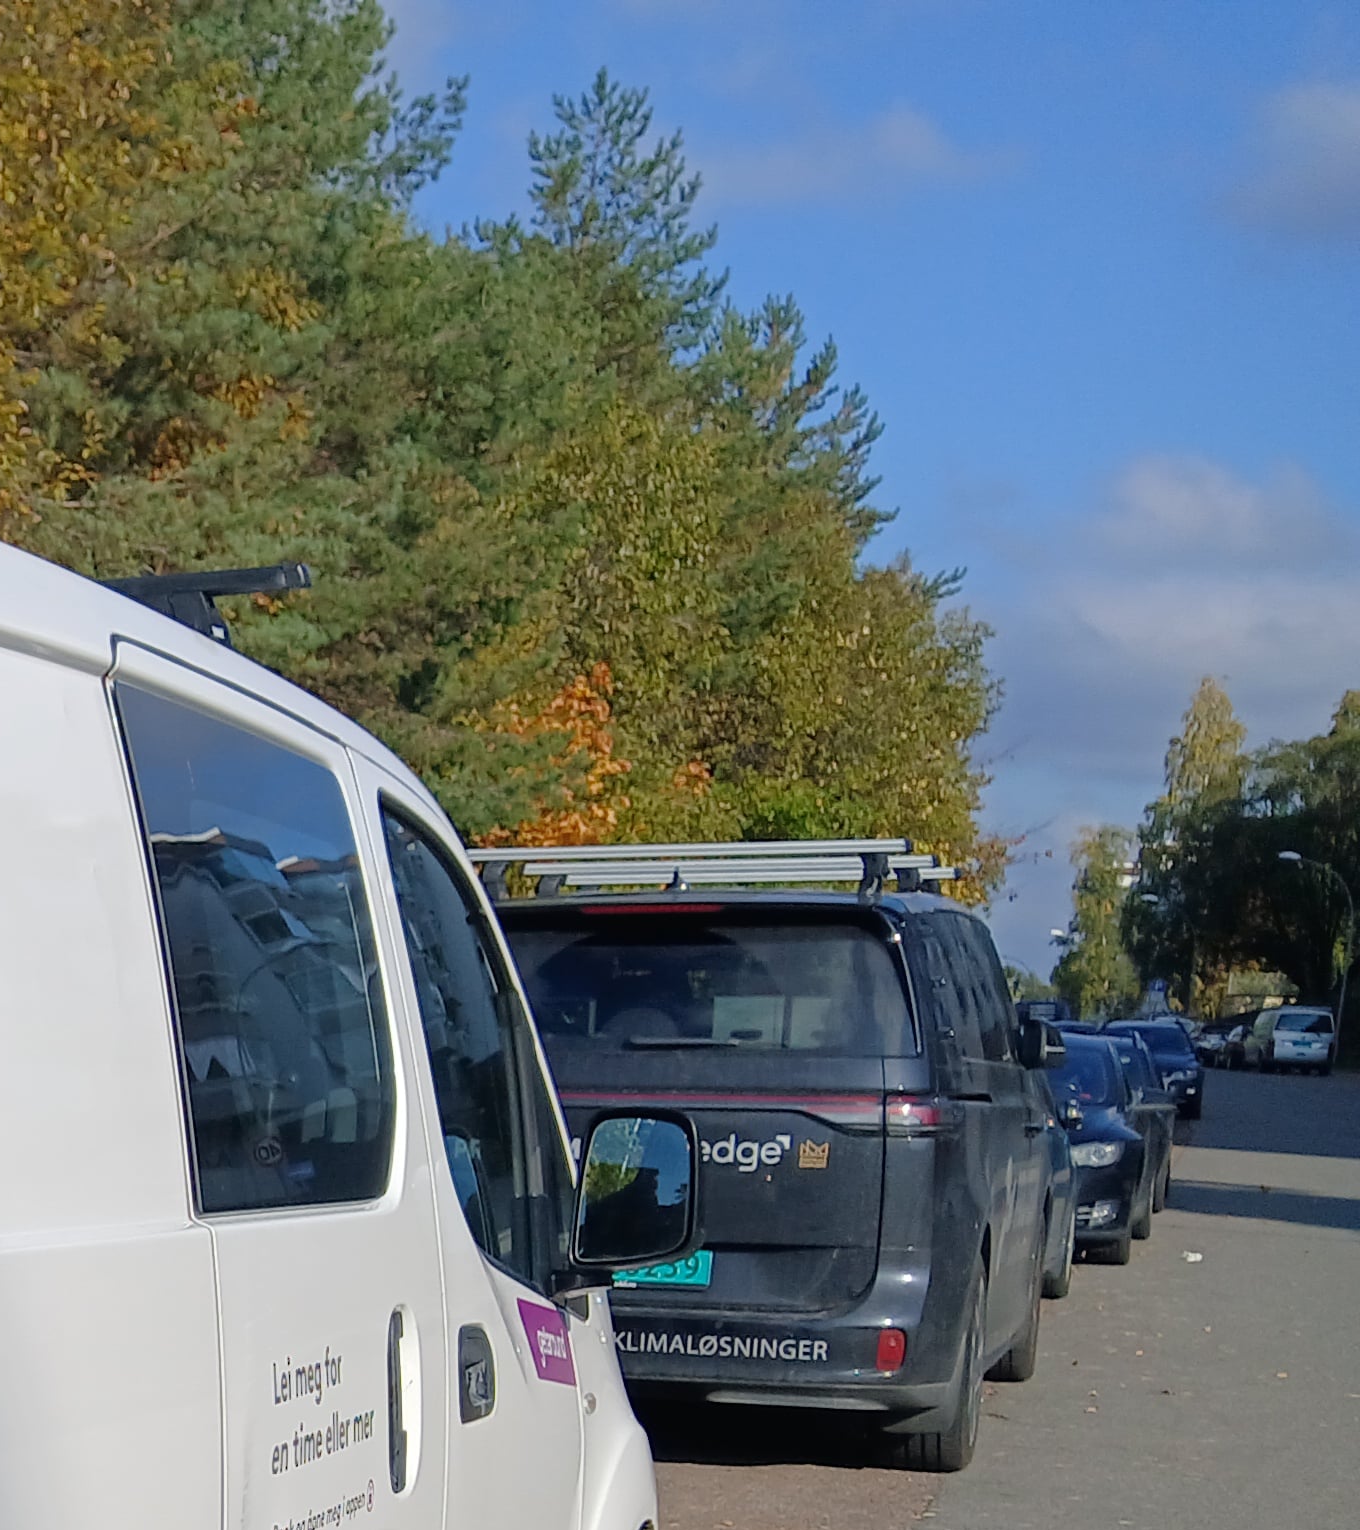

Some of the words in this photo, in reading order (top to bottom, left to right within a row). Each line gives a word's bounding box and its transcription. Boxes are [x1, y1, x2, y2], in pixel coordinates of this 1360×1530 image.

[614, 1331, 829, 1361] KLIMALØSNINGER
[273, 1357, 291, 1404] Lei
[295, 1361, 321, 1405] meg
[324, 1346, 342, 1388] for
[272, 1441, 288, 1474] en
[293, 1423, 322, 1467] time
[325, 1411, 350, 1454] eller
[353, 1410, 374, 1442] mer
[326, 1503, 342, 1528] meg
[346, 1493, 366, 1520] appen
